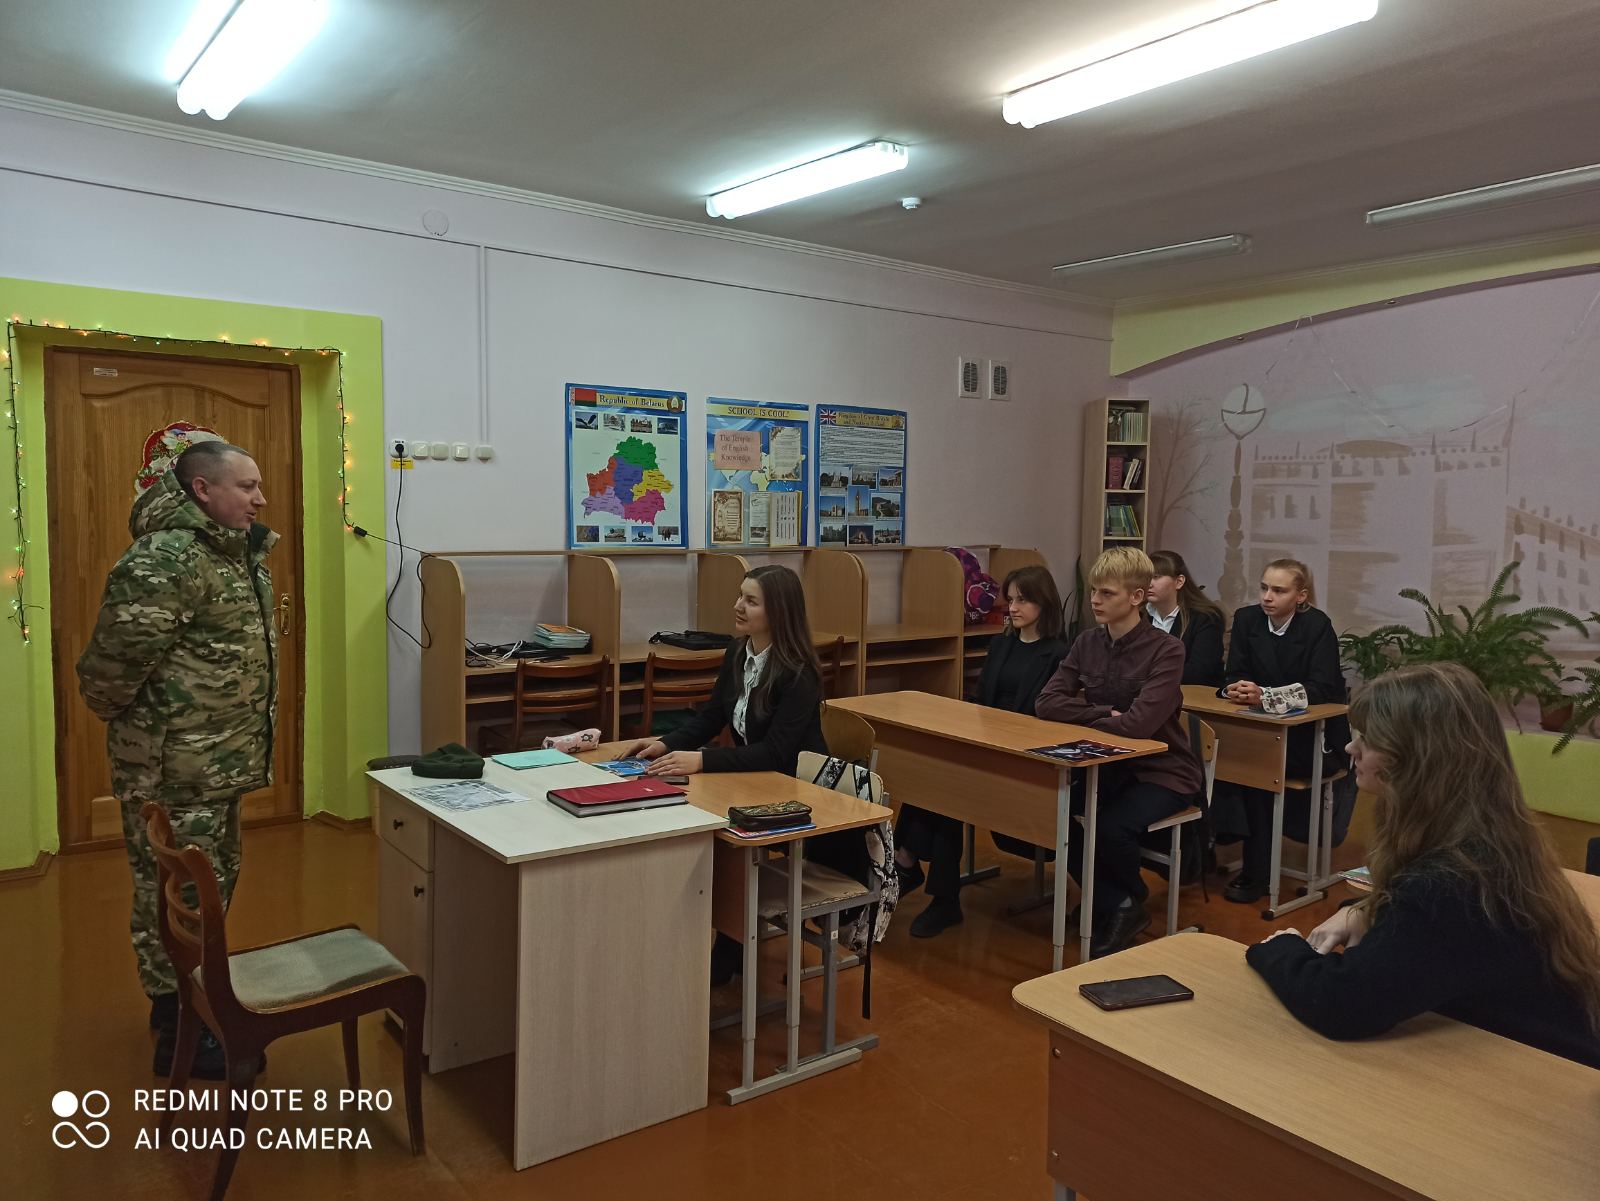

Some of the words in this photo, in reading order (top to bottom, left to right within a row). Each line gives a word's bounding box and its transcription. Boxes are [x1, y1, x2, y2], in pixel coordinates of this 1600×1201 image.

[599, 394, 629, 405] Republic
[641, 398, 665, 408] Belarus
[728, 406, 757, 416] SCHOOL
[760, 408, 766, 417] IS
[720, 434, 730, 442] The
